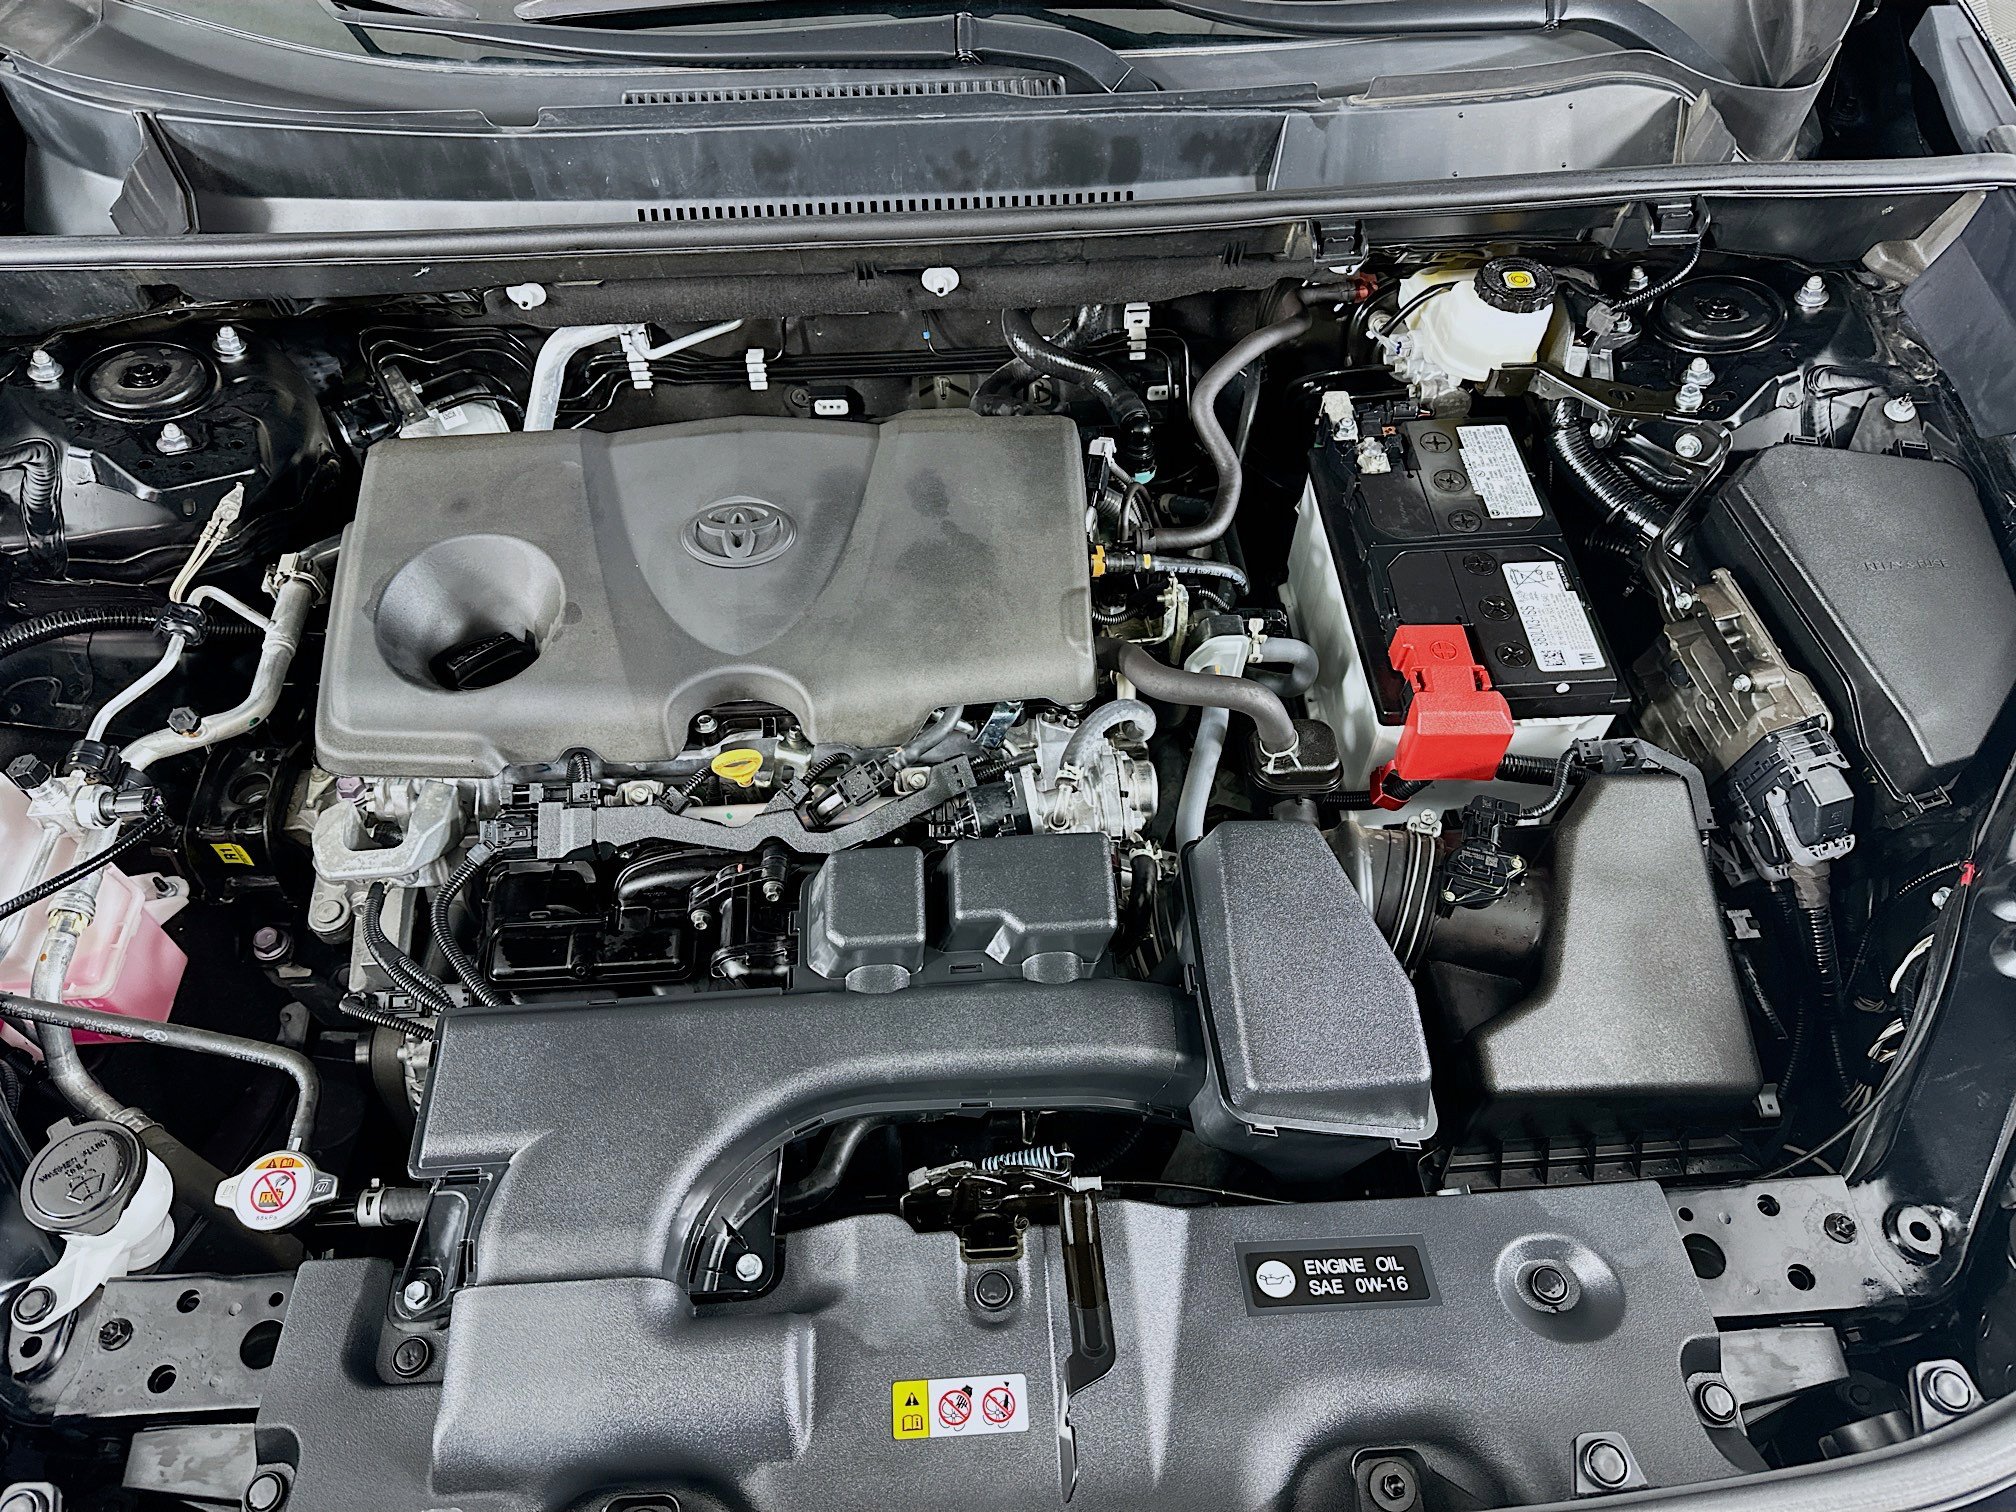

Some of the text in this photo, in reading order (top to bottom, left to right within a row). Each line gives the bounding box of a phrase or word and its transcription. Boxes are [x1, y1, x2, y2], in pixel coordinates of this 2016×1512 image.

[1917, 559, 1949, 569] FUSE
[39, 1139, 108, 1183] WASHER FLUID
[65, 1158, 87, 1177] ONLY
[1303, 1256, 1405, 1276] ENGINE OIL
[1309, 1275, 1409, 1296] SAE 0W-16
